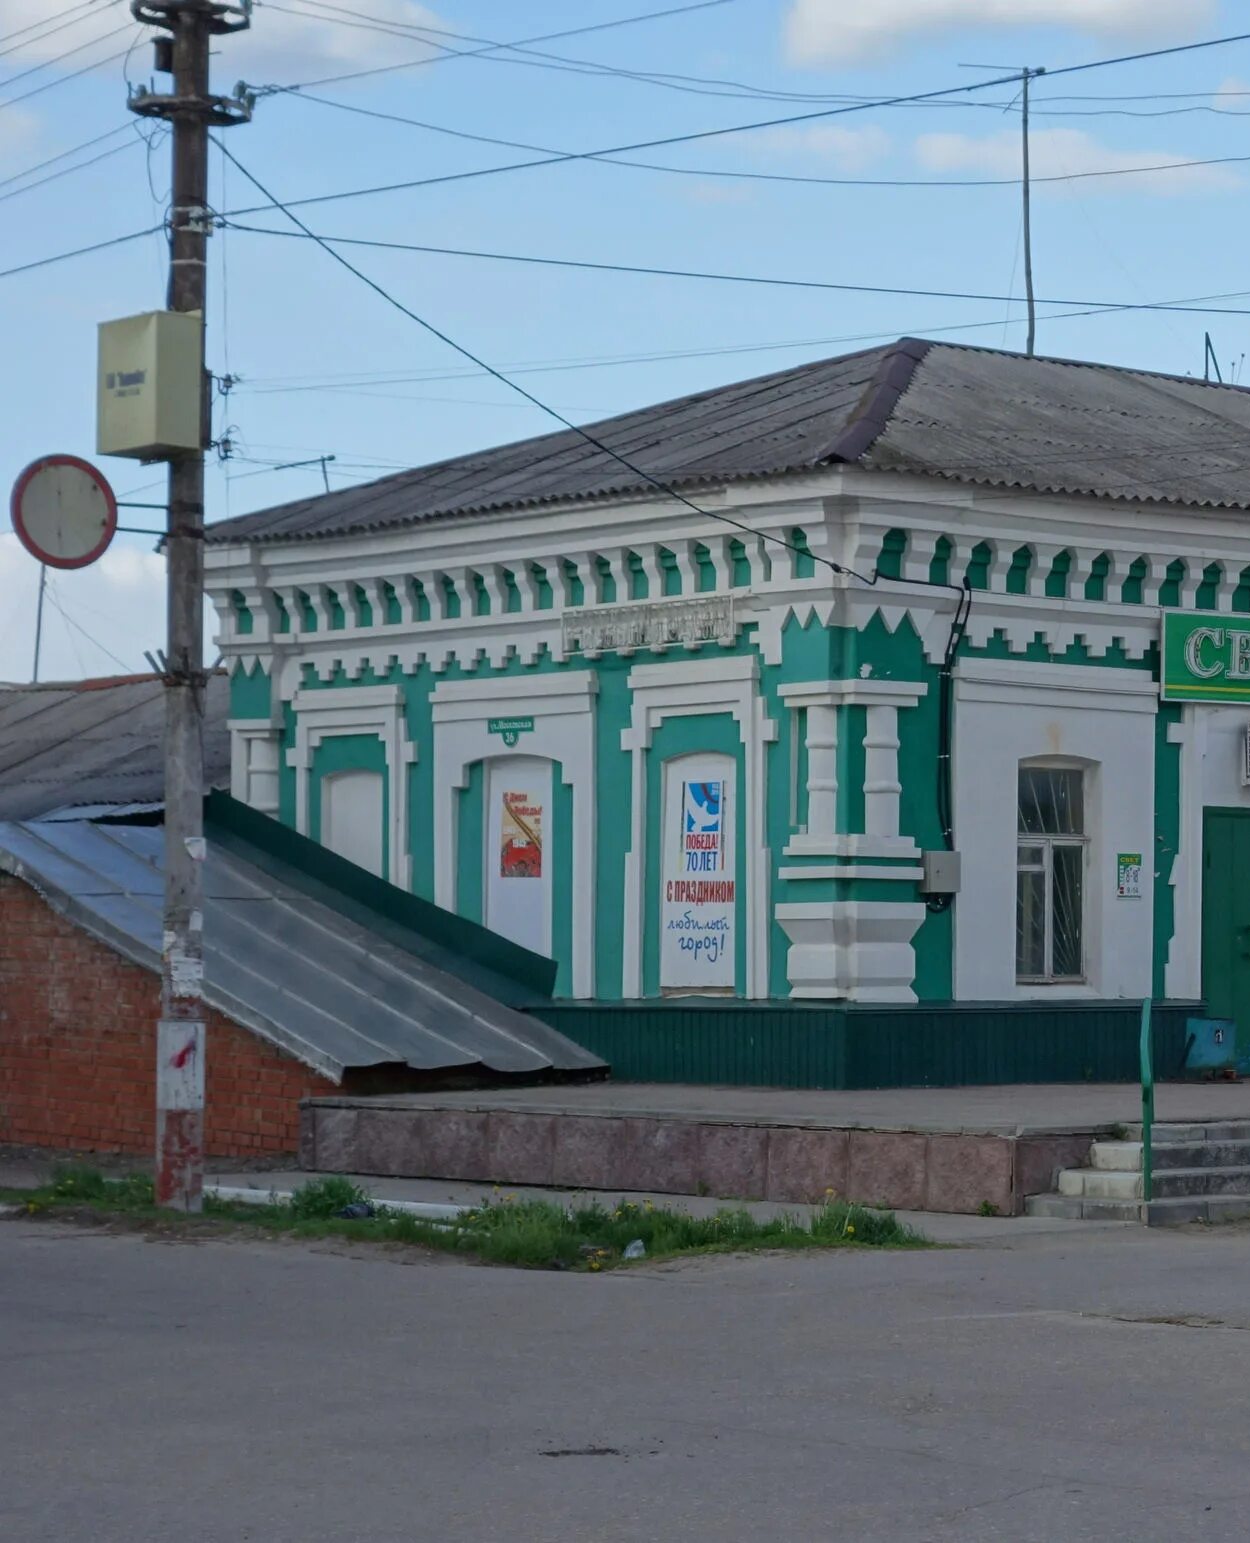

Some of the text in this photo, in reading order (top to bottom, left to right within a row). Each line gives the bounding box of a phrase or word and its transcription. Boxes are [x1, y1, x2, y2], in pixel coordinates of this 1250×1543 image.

[505, 732, 515, 743] 36
[686, 833, 718, 850] ПОБЕДА!
[686, 851, 718, 871] 70 ЛЕТ
[666, 880, 735, 906] С ПРАЗДНИКОМ
[667, 910, 730, 930] любимый
[678, 933, 725, 963] город!
